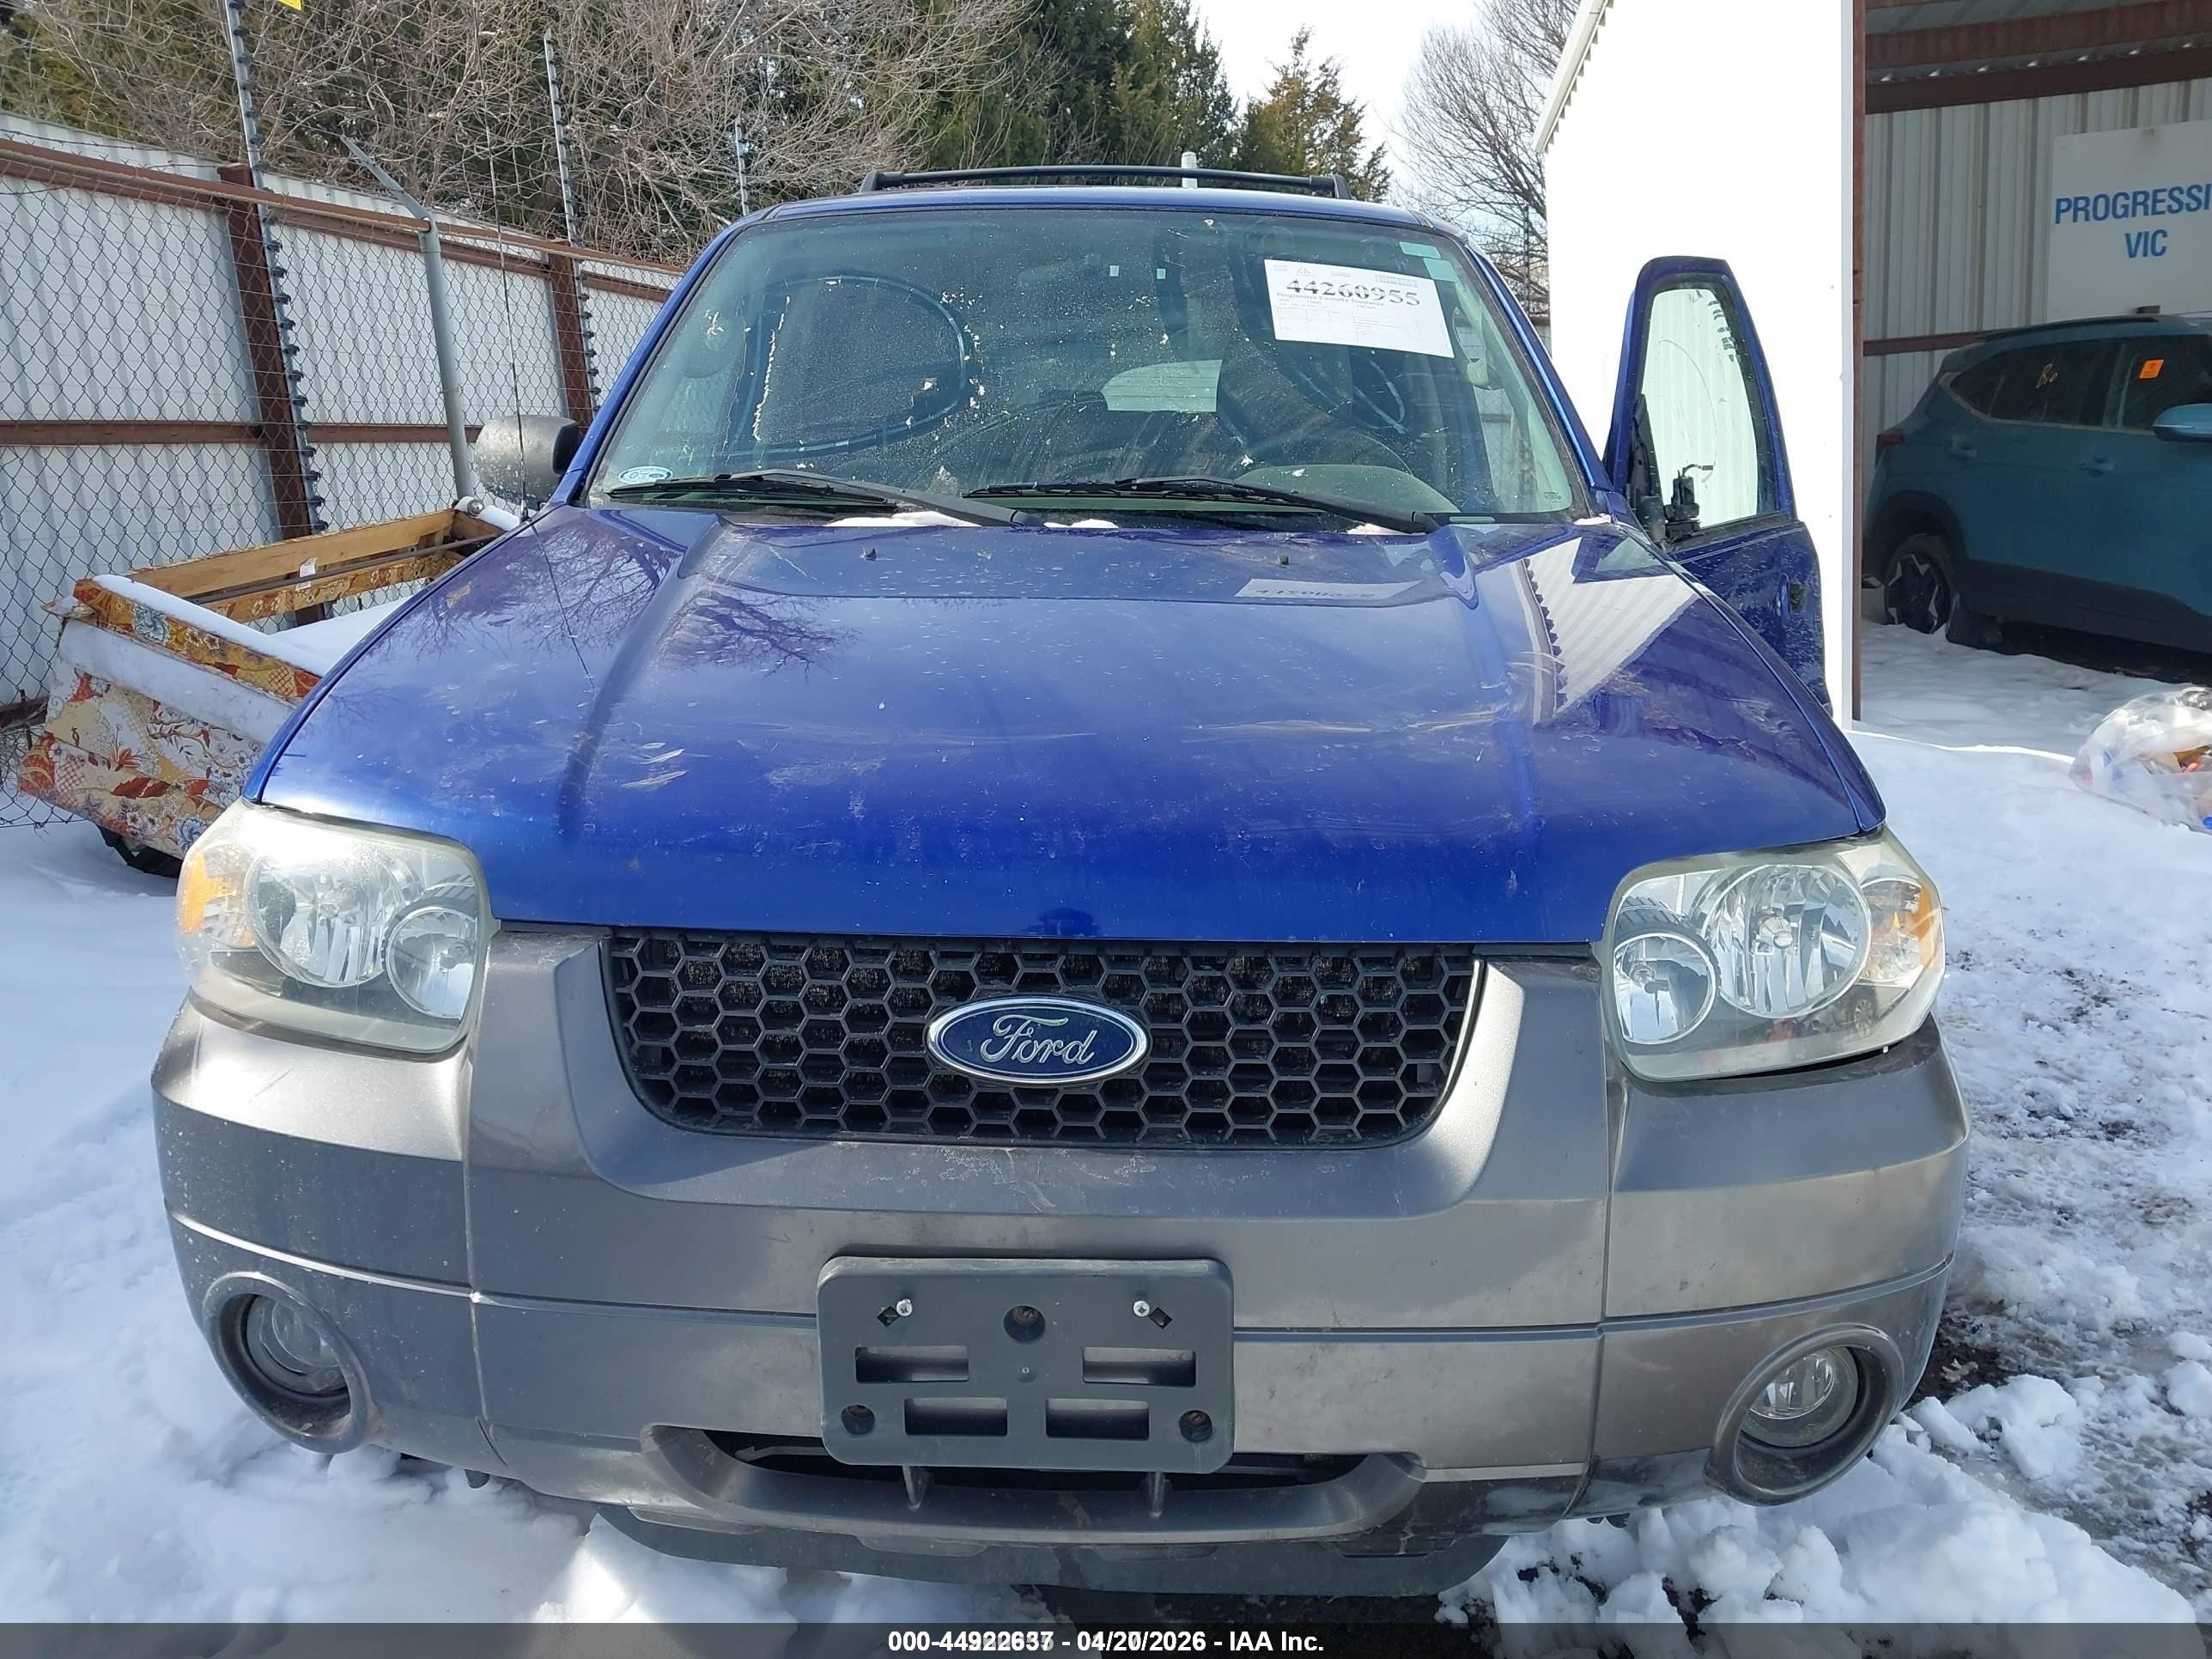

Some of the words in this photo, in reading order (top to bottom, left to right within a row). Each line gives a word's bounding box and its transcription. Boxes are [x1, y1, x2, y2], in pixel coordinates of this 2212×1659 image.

[2055, 184, 2211, 224] PROGRESSI
[2124, 228, 2168, 258] VIC
[1285, 278, 1420, 307] 44260955
[980, 1014, 1097, 1065] Ford
